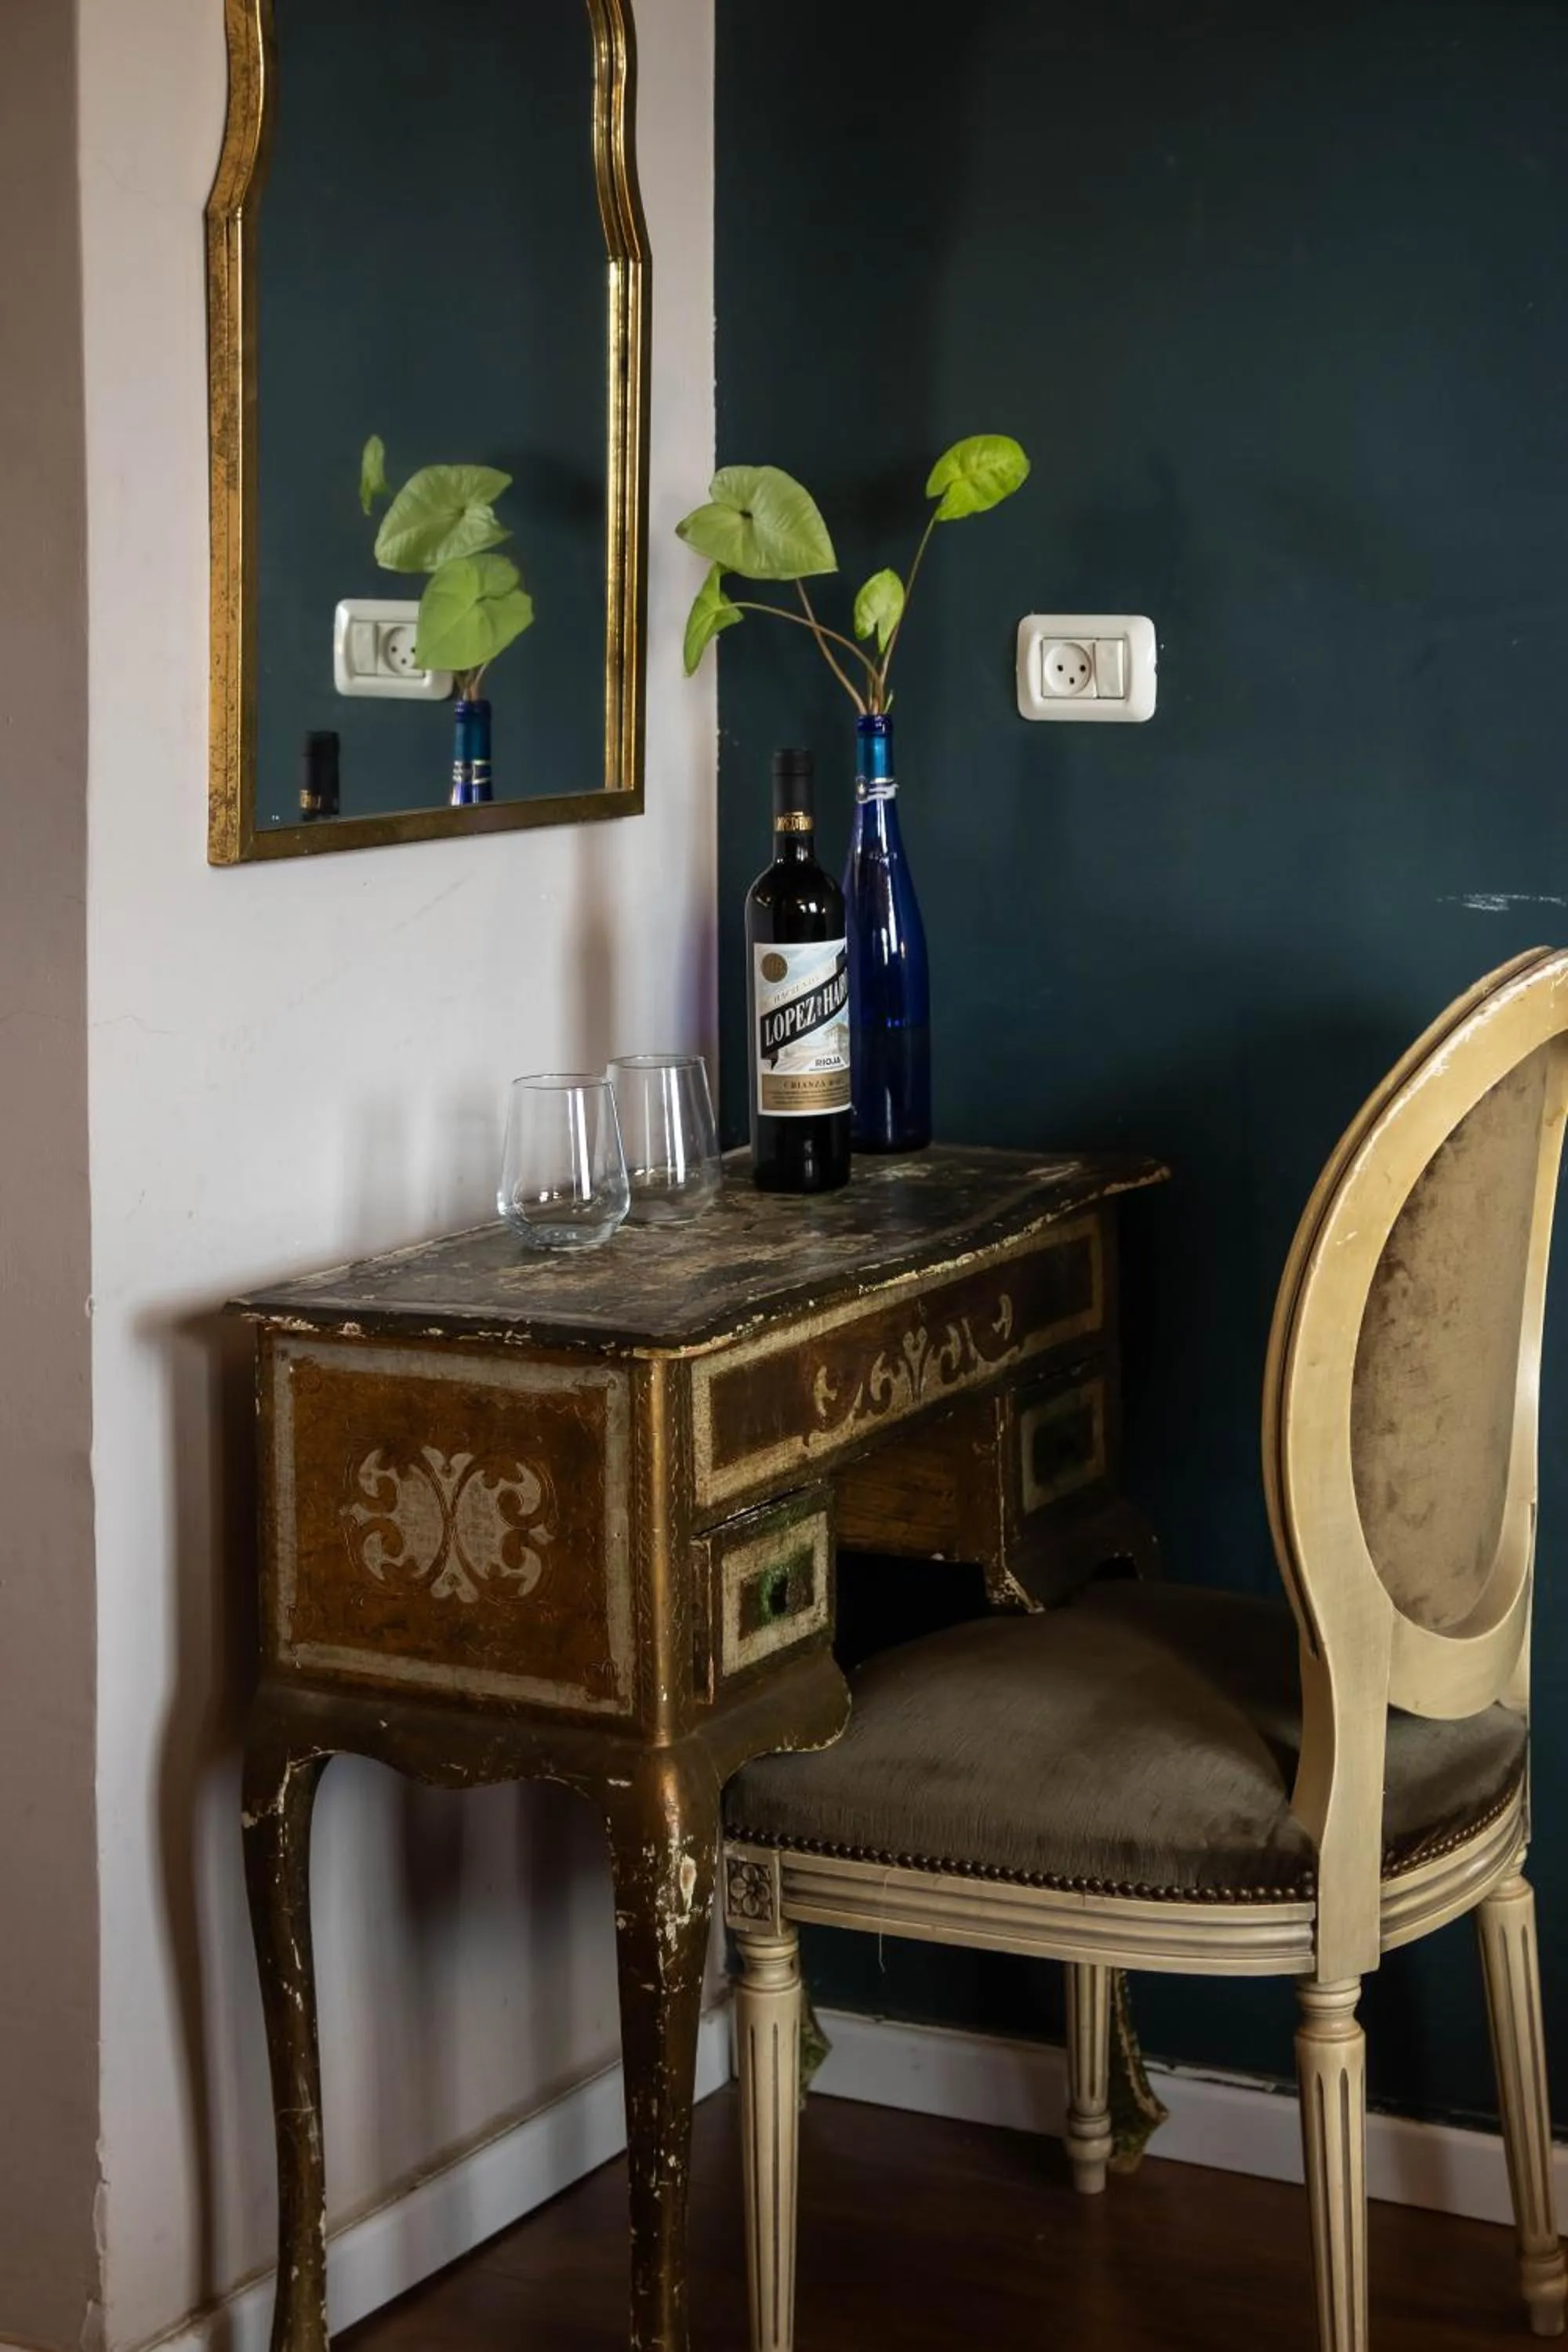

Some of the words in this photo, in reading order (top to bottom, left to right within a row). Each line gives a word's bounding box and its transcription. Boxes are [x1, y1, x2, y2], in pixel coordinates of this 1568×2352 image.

[765, 996, 816, 1047] LOPEZ
[815, 1056, 841, 1066] RIOJA
[783, 1080, 826, 1089] CRIANZA
